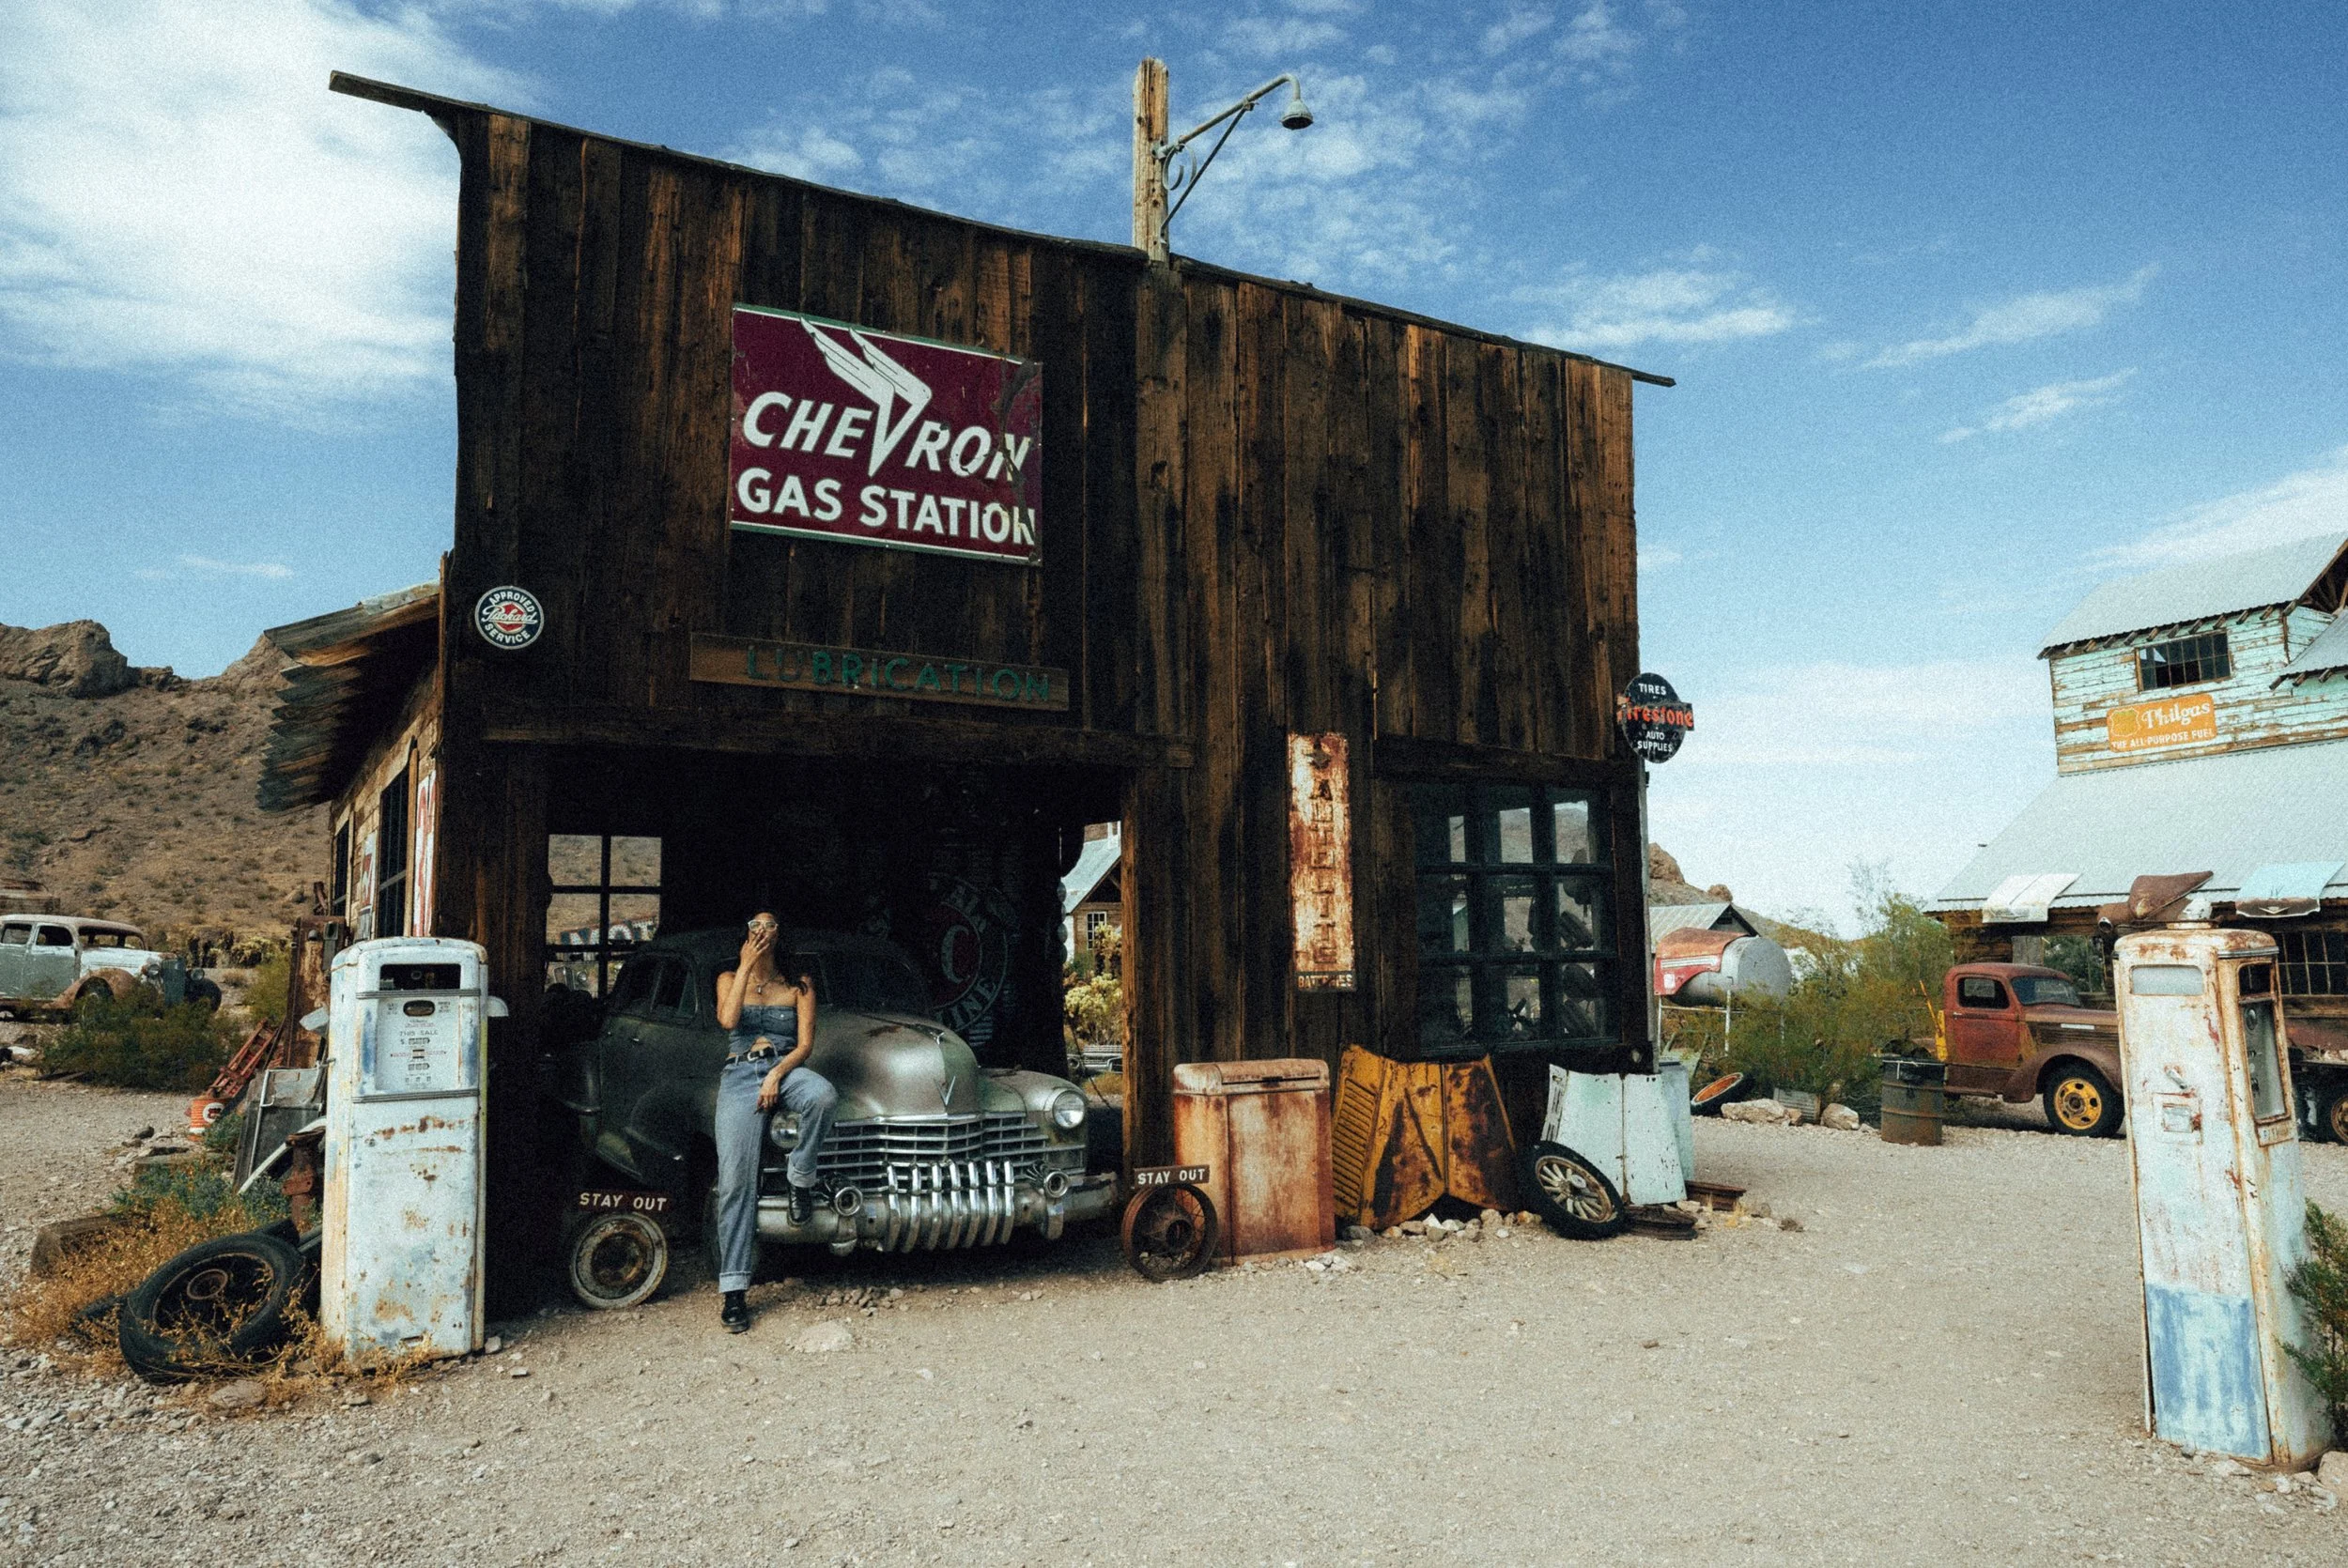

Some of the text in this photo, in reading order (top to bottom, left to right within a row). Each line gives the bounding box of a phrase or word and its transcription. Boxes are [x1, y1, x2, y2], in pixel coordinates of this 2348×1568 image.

[742, 377, 1031, 481] CHEVRON
[737, 467, 1035, 546] GAS STATION
[488, 591, 535, 613] APPROVED
[481, 605, 538, 625] Packard
[484, 623, 531, 644] SERVICE
[745, 644, 1050, 702] LUBRICATION
[1638, 683, 1667, 696] TIRES
[1615, 694, 1694, 728] Firestone
[2140, 702, 2211, 730] Philgas
[1637, 740, 1673, 752] SUPPLIES
[1645, 730, 1665, 741] AUTO
[2111, 740, 2127, 749] THE
[2191, 728, 2215, 739] FUEL
[1137, 1168, 1206, 1185] STAY OUT
[579, 1192, 668, 1211] STAY OUT
